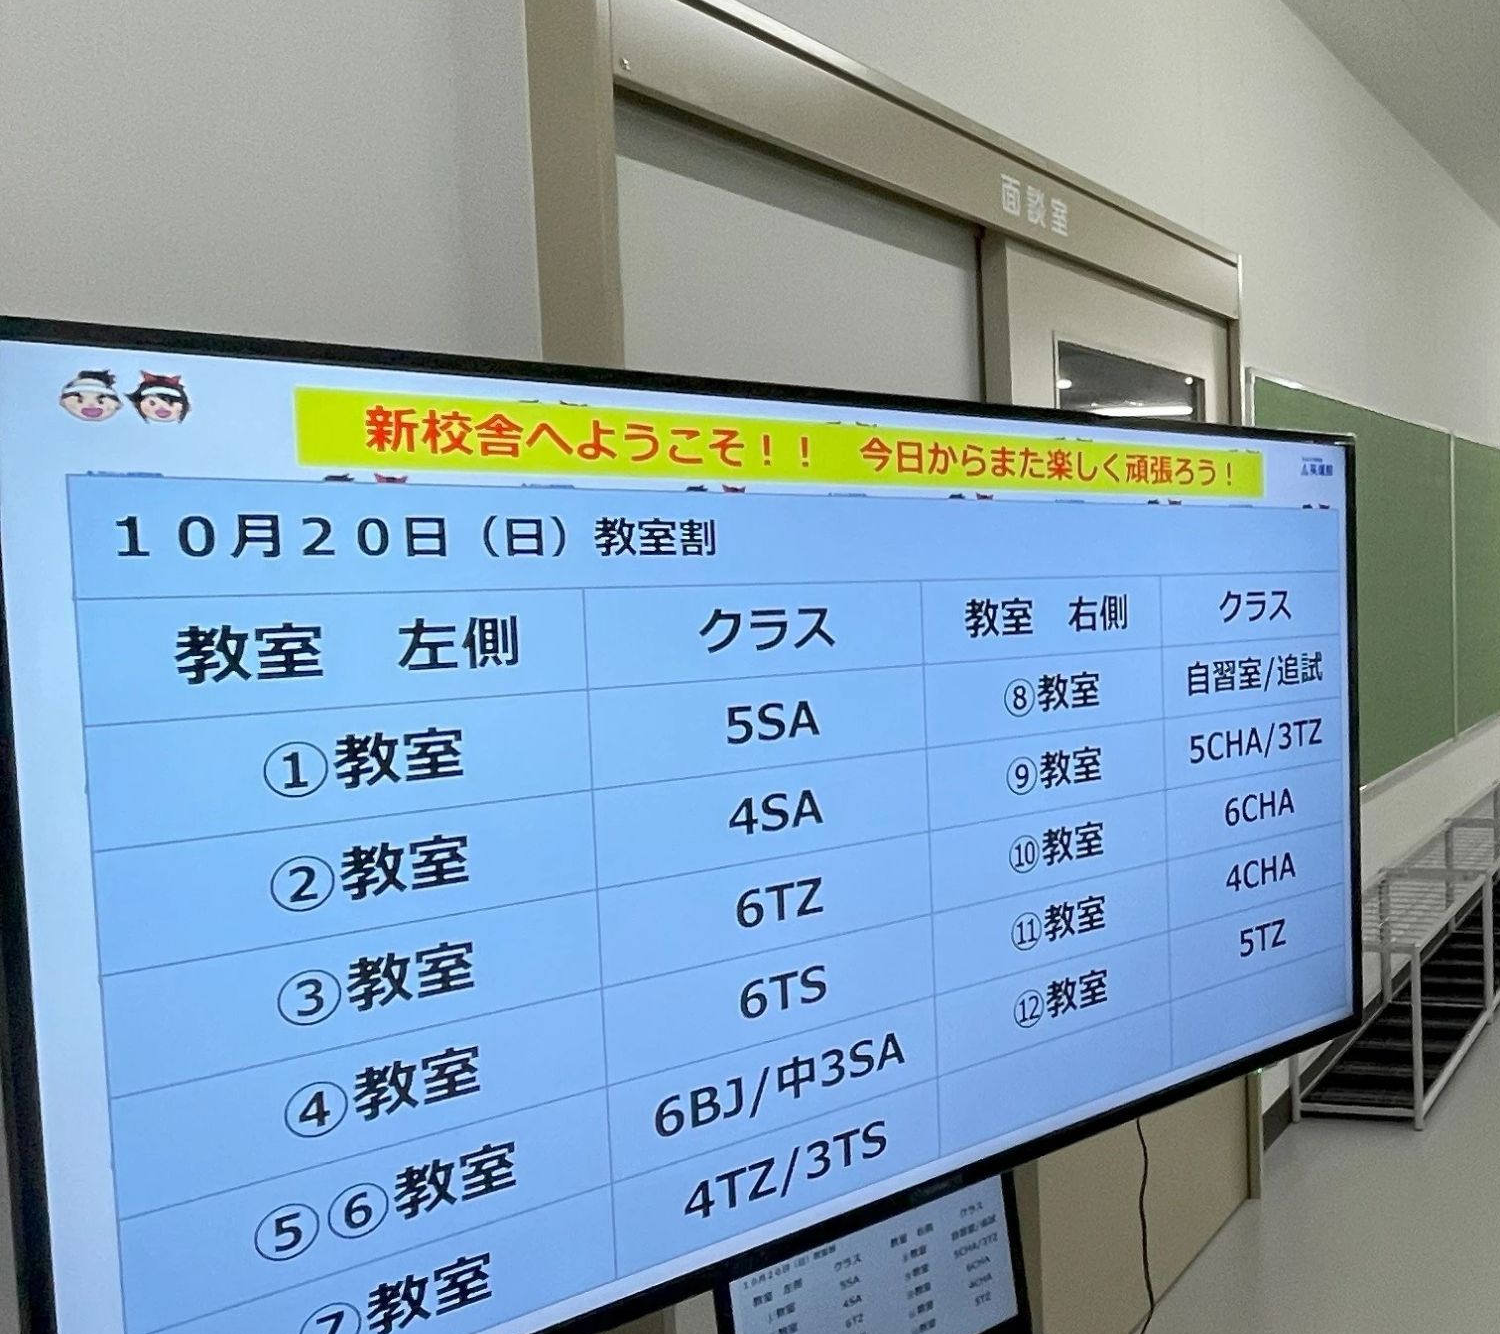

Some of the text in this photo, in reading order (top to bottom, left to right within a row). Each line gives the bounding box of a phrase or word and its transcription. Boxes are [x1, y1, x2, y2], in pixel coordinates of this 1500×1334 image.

[366, 404, 1234, 488] 新校舎へようこそ！！ 今日からまた楽しく頑張ろう！
[698, 607, 836, 654] クラス
[964, 593, 1128, 639] 教室 右側
[1219, 590, 1292, 624] クラス
[173, 615, 519, 685] 教室 左側
[1187, 651, 1324, 697] 自習室/追試
[726, 700, 821, 745] 5SA
[1190, 717, 1323, 764] 5CHA/3TZ
[728, 789, 824, 836] 4SA
[1225, 787, 1295, 827] 6CHA
[1225, 852, 1296, 892] 4CHA
[736, 876, 824, 928] 6TZ
[1240, 918, 1287, 958] 5TZ
[740, 964, 827, 1019] 6TS
[655, 1032, 906, 1140] 6BJ/中3SA
[683, 1120, 888, 1220] 4TZ/3TS
